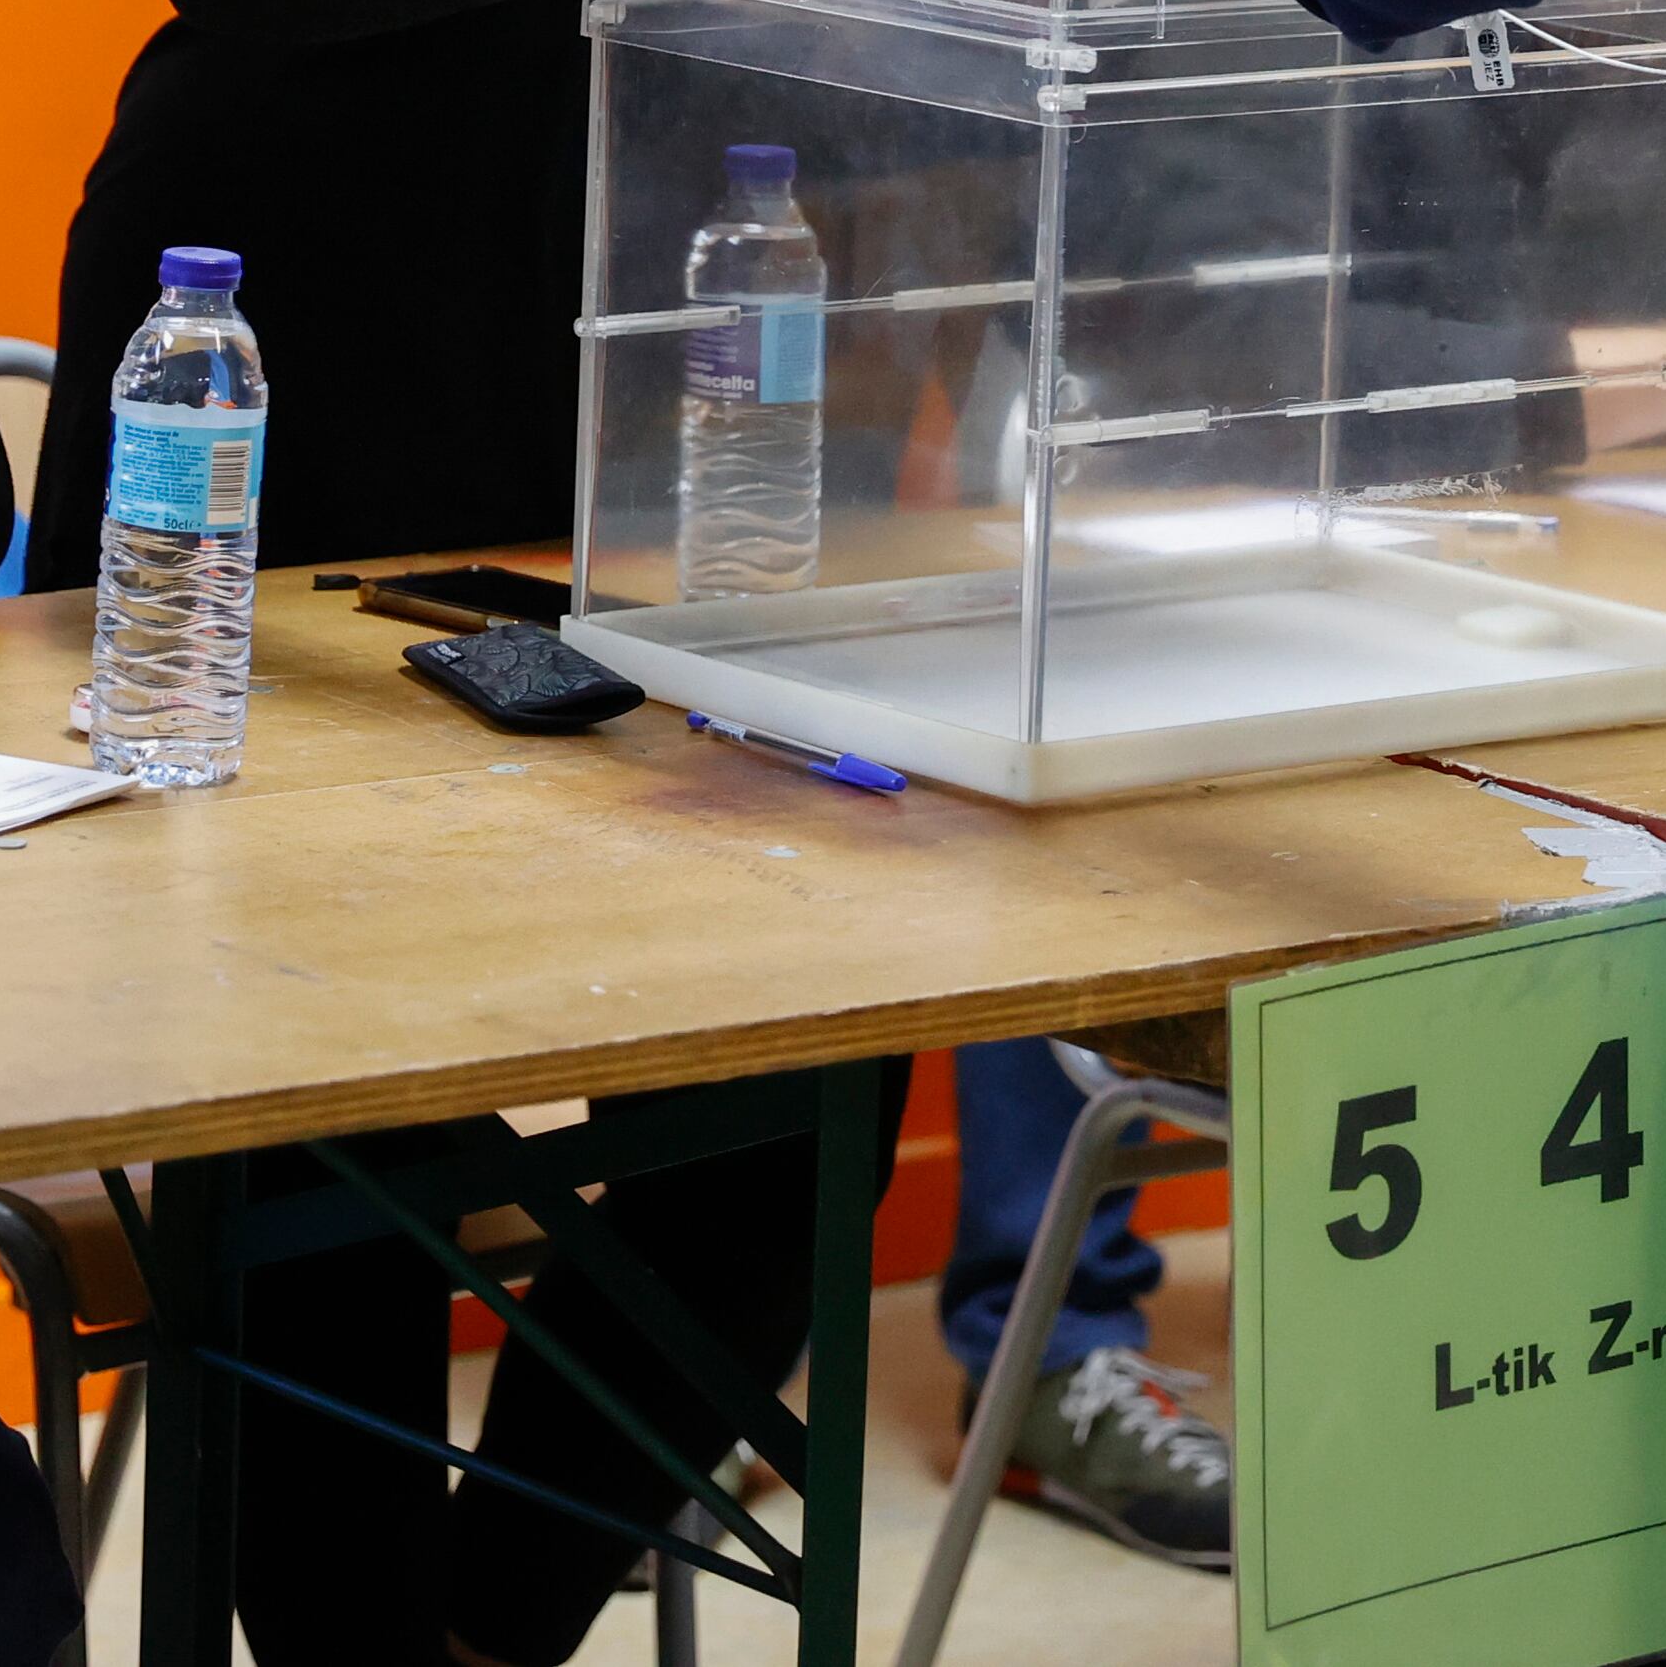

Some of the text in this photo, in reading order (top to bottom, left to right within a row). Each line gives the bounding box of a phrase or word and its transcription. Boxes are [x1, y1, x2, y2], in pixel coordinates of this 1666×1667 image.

[1325, 1085, 1423, 1261] 5
[1540, 1036, 1644, 1203] 4
[1434, 1341, 1556, 1412] L-tik
